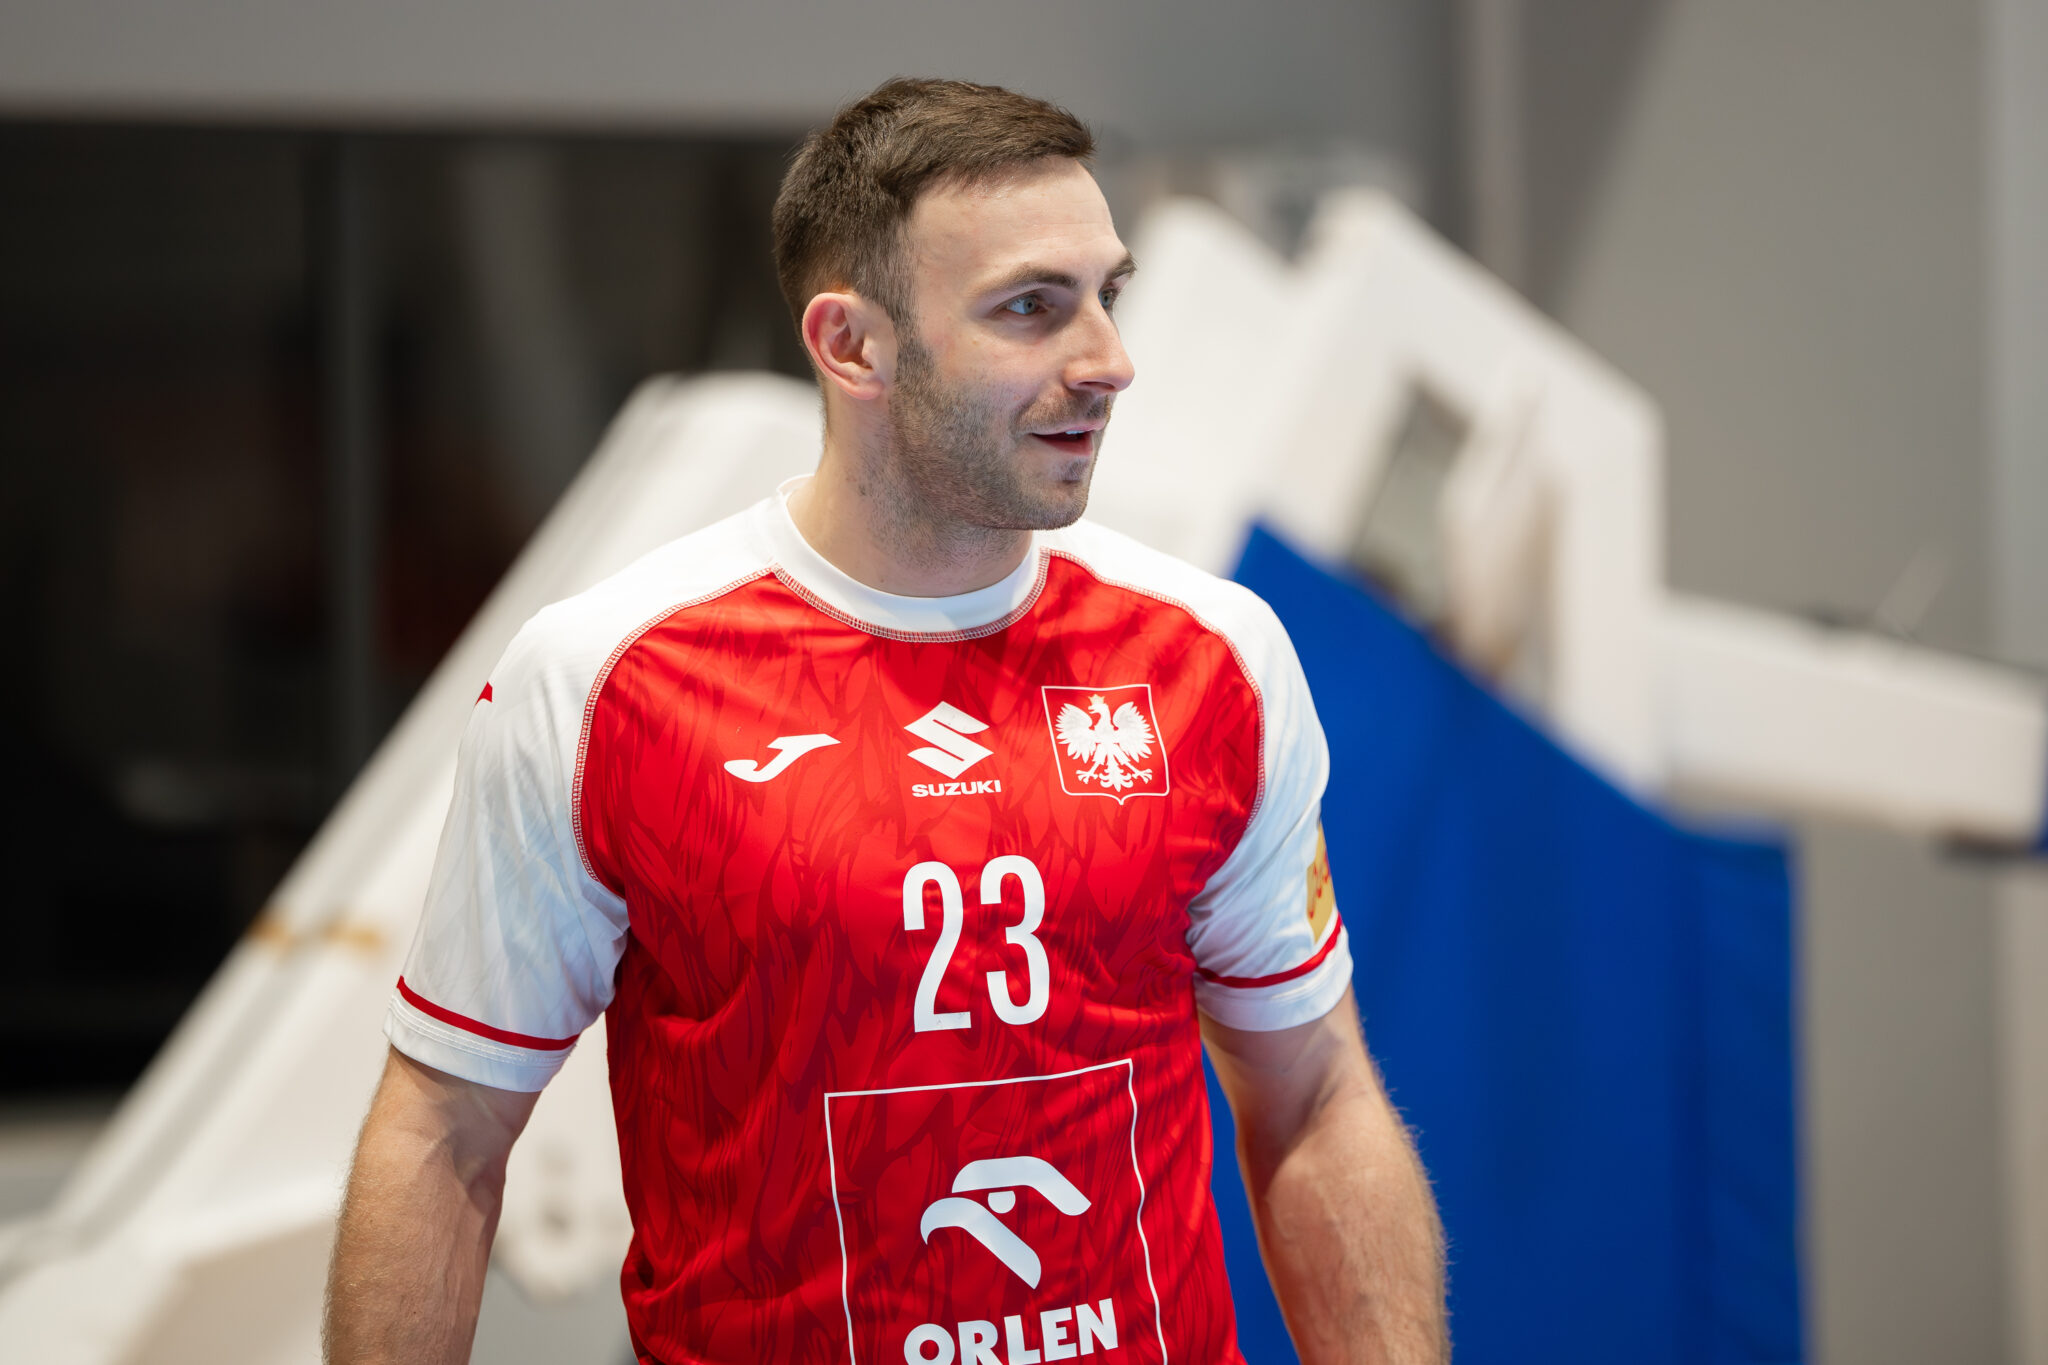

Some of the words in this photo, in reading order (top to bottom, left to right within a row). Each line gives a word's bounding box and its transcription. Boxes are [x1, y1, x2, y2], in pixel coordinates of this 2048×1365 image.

[911, 779, 1002, 798] SUZUKI
[902, 854, 1050, 1033] 23
[903, 1297, 1119, 1365] ORLEN
